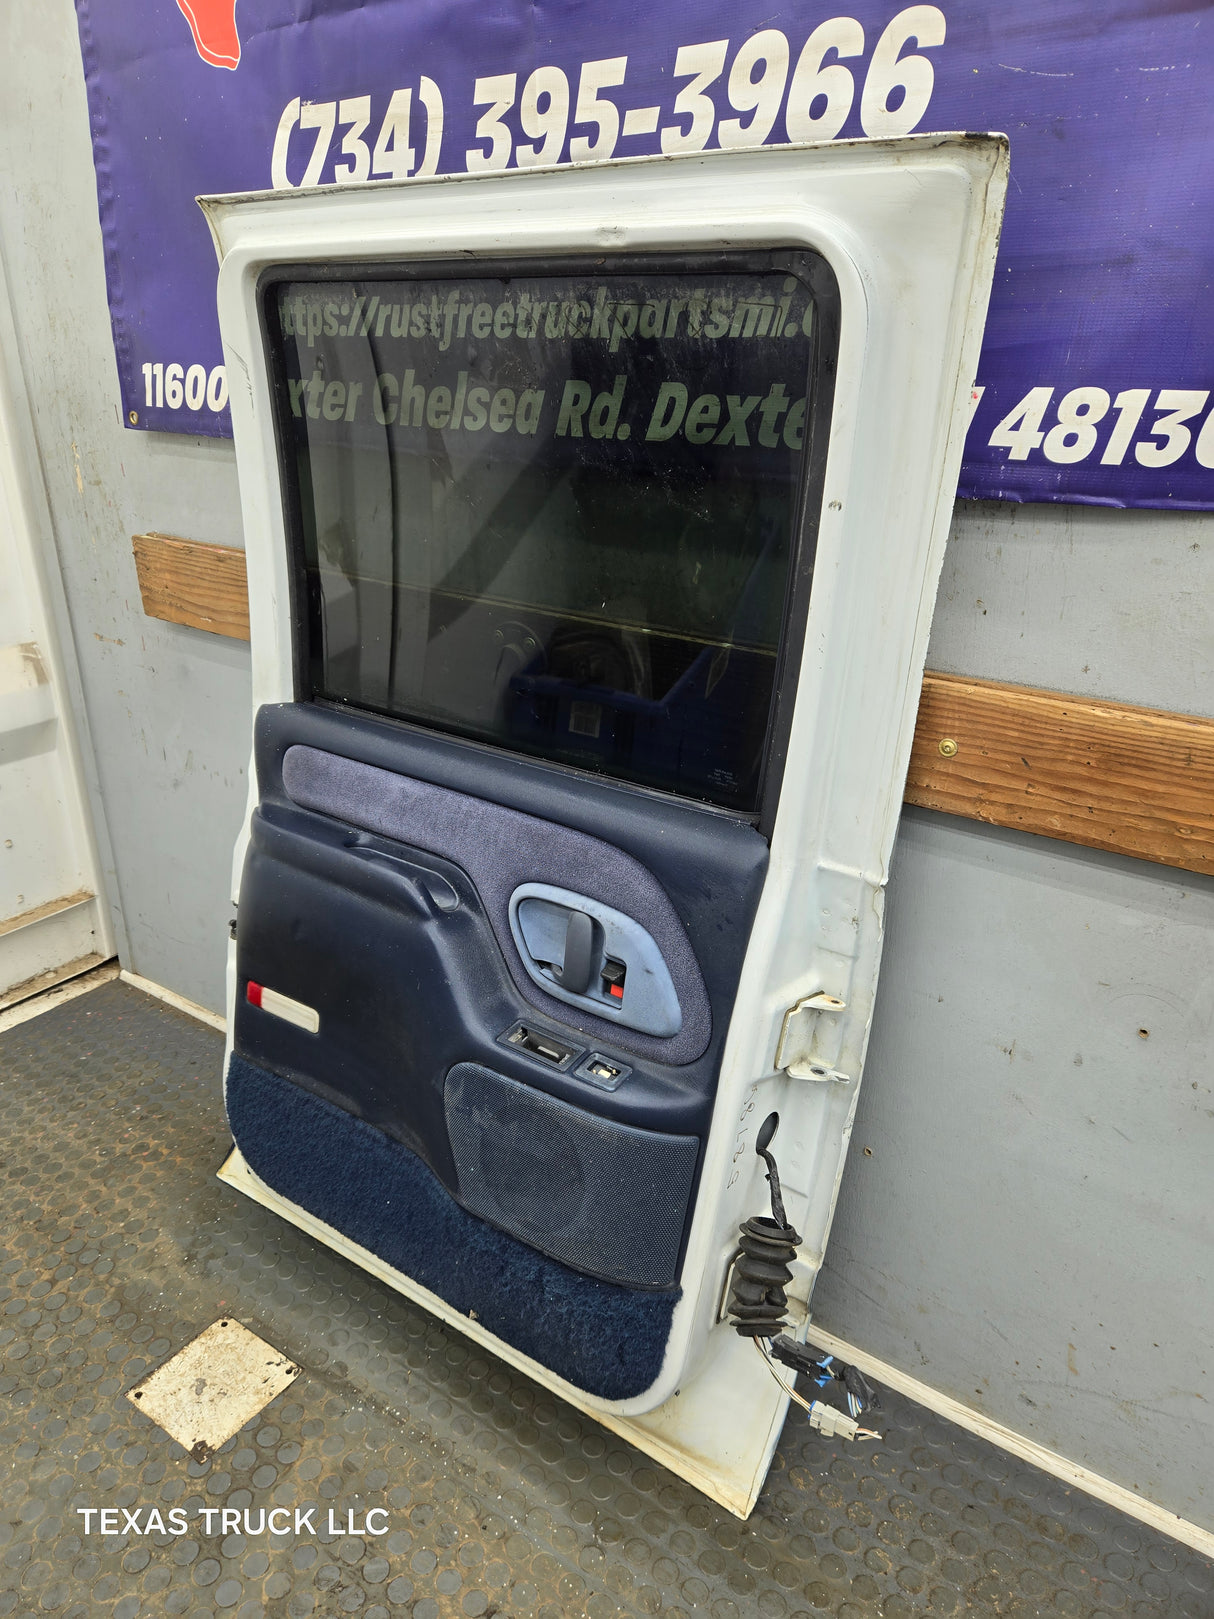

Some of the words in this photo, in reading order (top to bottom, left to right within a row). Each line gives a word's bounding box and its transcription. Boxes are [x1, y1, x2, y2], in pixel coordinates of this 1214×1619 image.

[271, 75, 444, 189] (734)
[465, 4, 947, 172] 395-3966
[281, 277, 813, 353] ttps://rustfreetruckpartsmi.
[142, 362, 229, 413] 11600
[373, 369, 546, 435] Chelsea
[555, 375, 631, 441] Rd.
